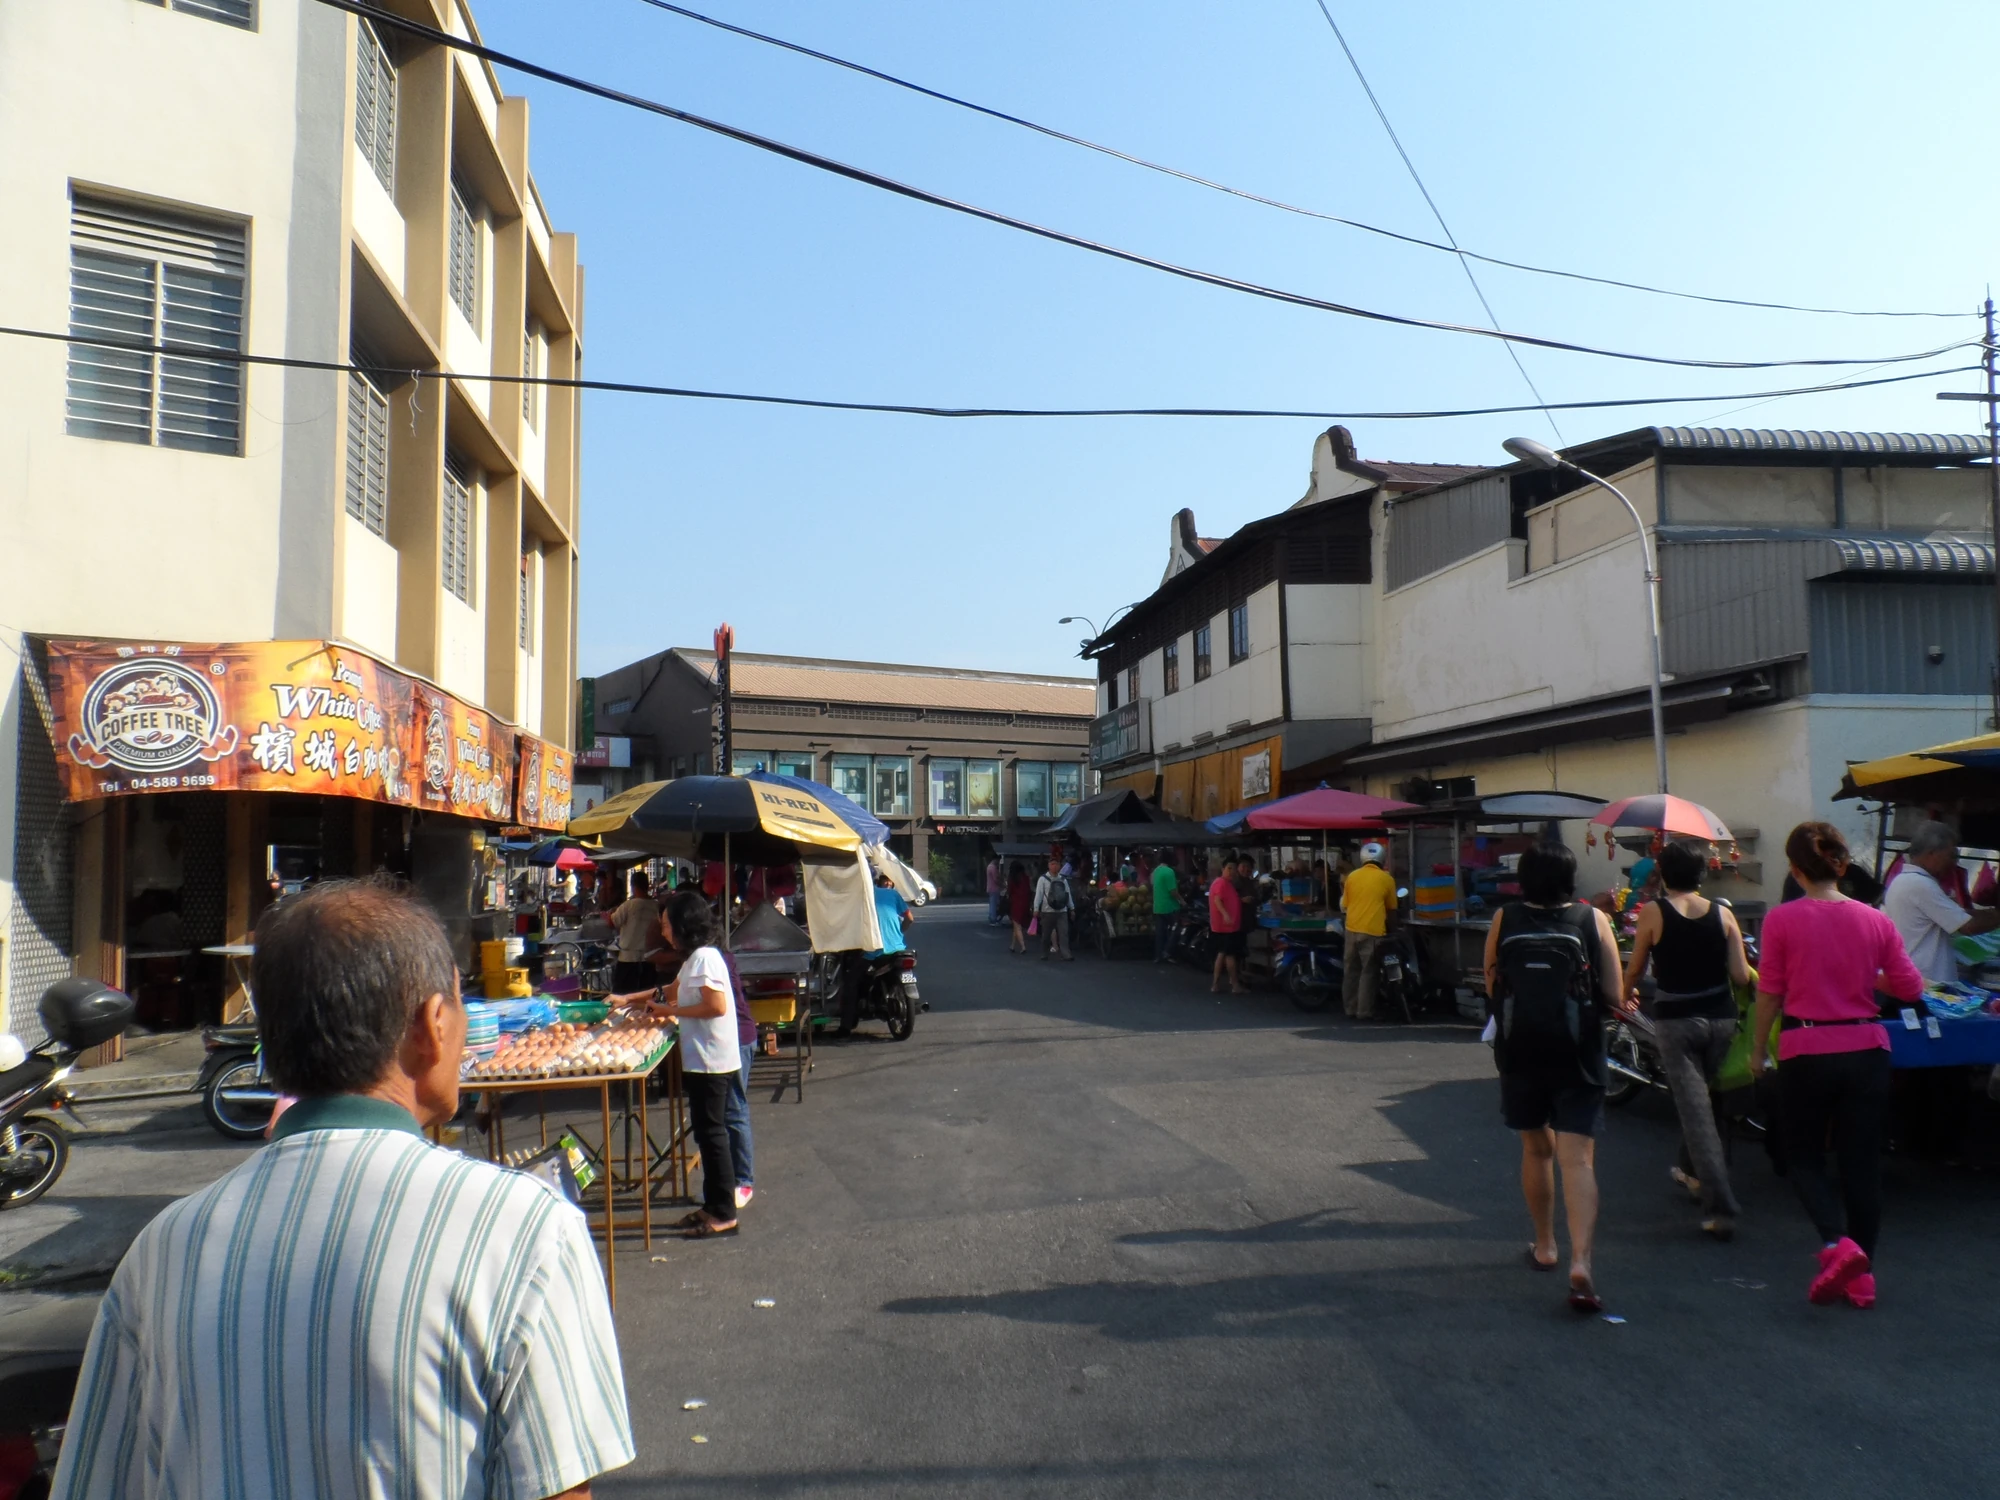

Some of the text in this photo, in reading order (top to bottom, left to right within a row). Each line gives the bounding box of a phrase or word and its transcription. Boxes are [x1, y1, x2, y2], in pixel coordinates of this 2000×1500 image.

[270, 684, 382, 734] White Coffee
[101, 711, 204, 742] COFFEE TREE
[112, 736, 194, 759] PREMIUM QUALITY
[99, 774, 215, 793] Tel 04-588 9699
[761, 791, 820, 814] HI-REV
